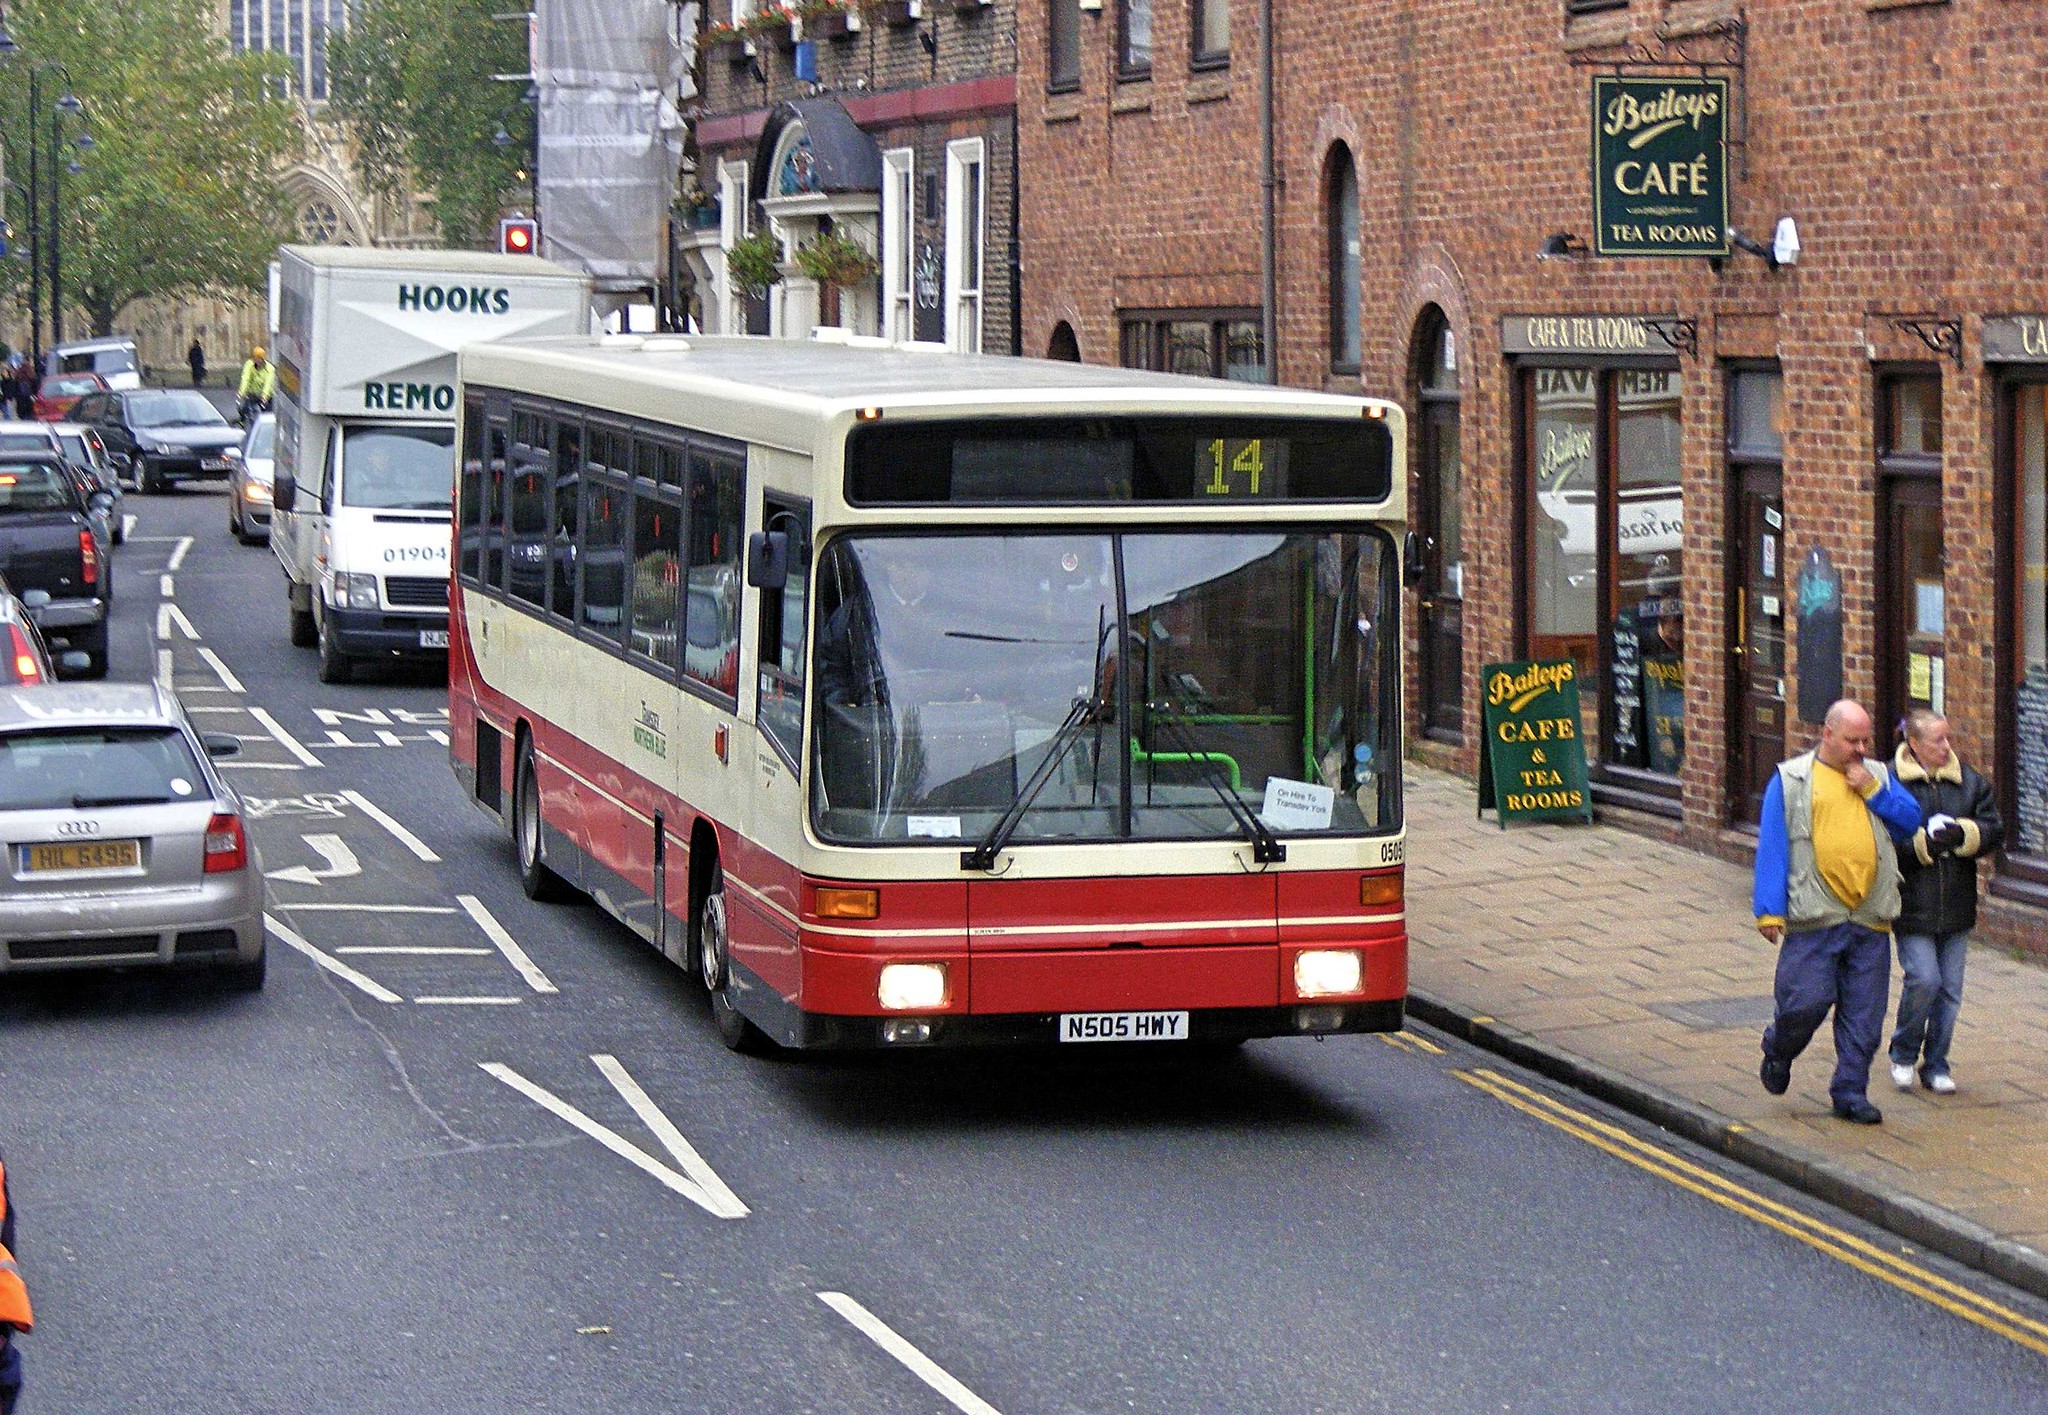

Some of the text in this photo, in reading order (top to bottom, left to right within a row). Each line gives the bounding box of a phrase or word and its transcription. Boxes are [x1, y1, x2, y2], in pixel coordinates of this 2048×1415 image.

[1603, 87, 1719, 138] Baileys
[1614, 152, 1709, 196] CAFÉ
[1610, 224, 1718, 243] TEA ROOMS
[398, 283, 511, 315] HOOKS
[1527, 317, 1558, 348] CAFE
[1572, 318, 1595, 348] TEA
[1599, 316, 1647, 349] ROOMS
[1206, 438, 1264, 494] 14
[383, 547, 447, 562] 01904
[1488, 662, 1573, 706] Baileys
[1498, 717, 1575, 743] CAFE
[1531, 747, 1547, 764] &
[1520, 769, 1563, 787] TEA
[1276, 798, 1327, 814] Transdev York
[1277, 788, 1317, 803] On Hire To
[1506, 789, 1583, 811] ROOMS
[1381, 841, 1402, 863] 0505
[1068, 1015, 1180, 1038] N505 HWY
